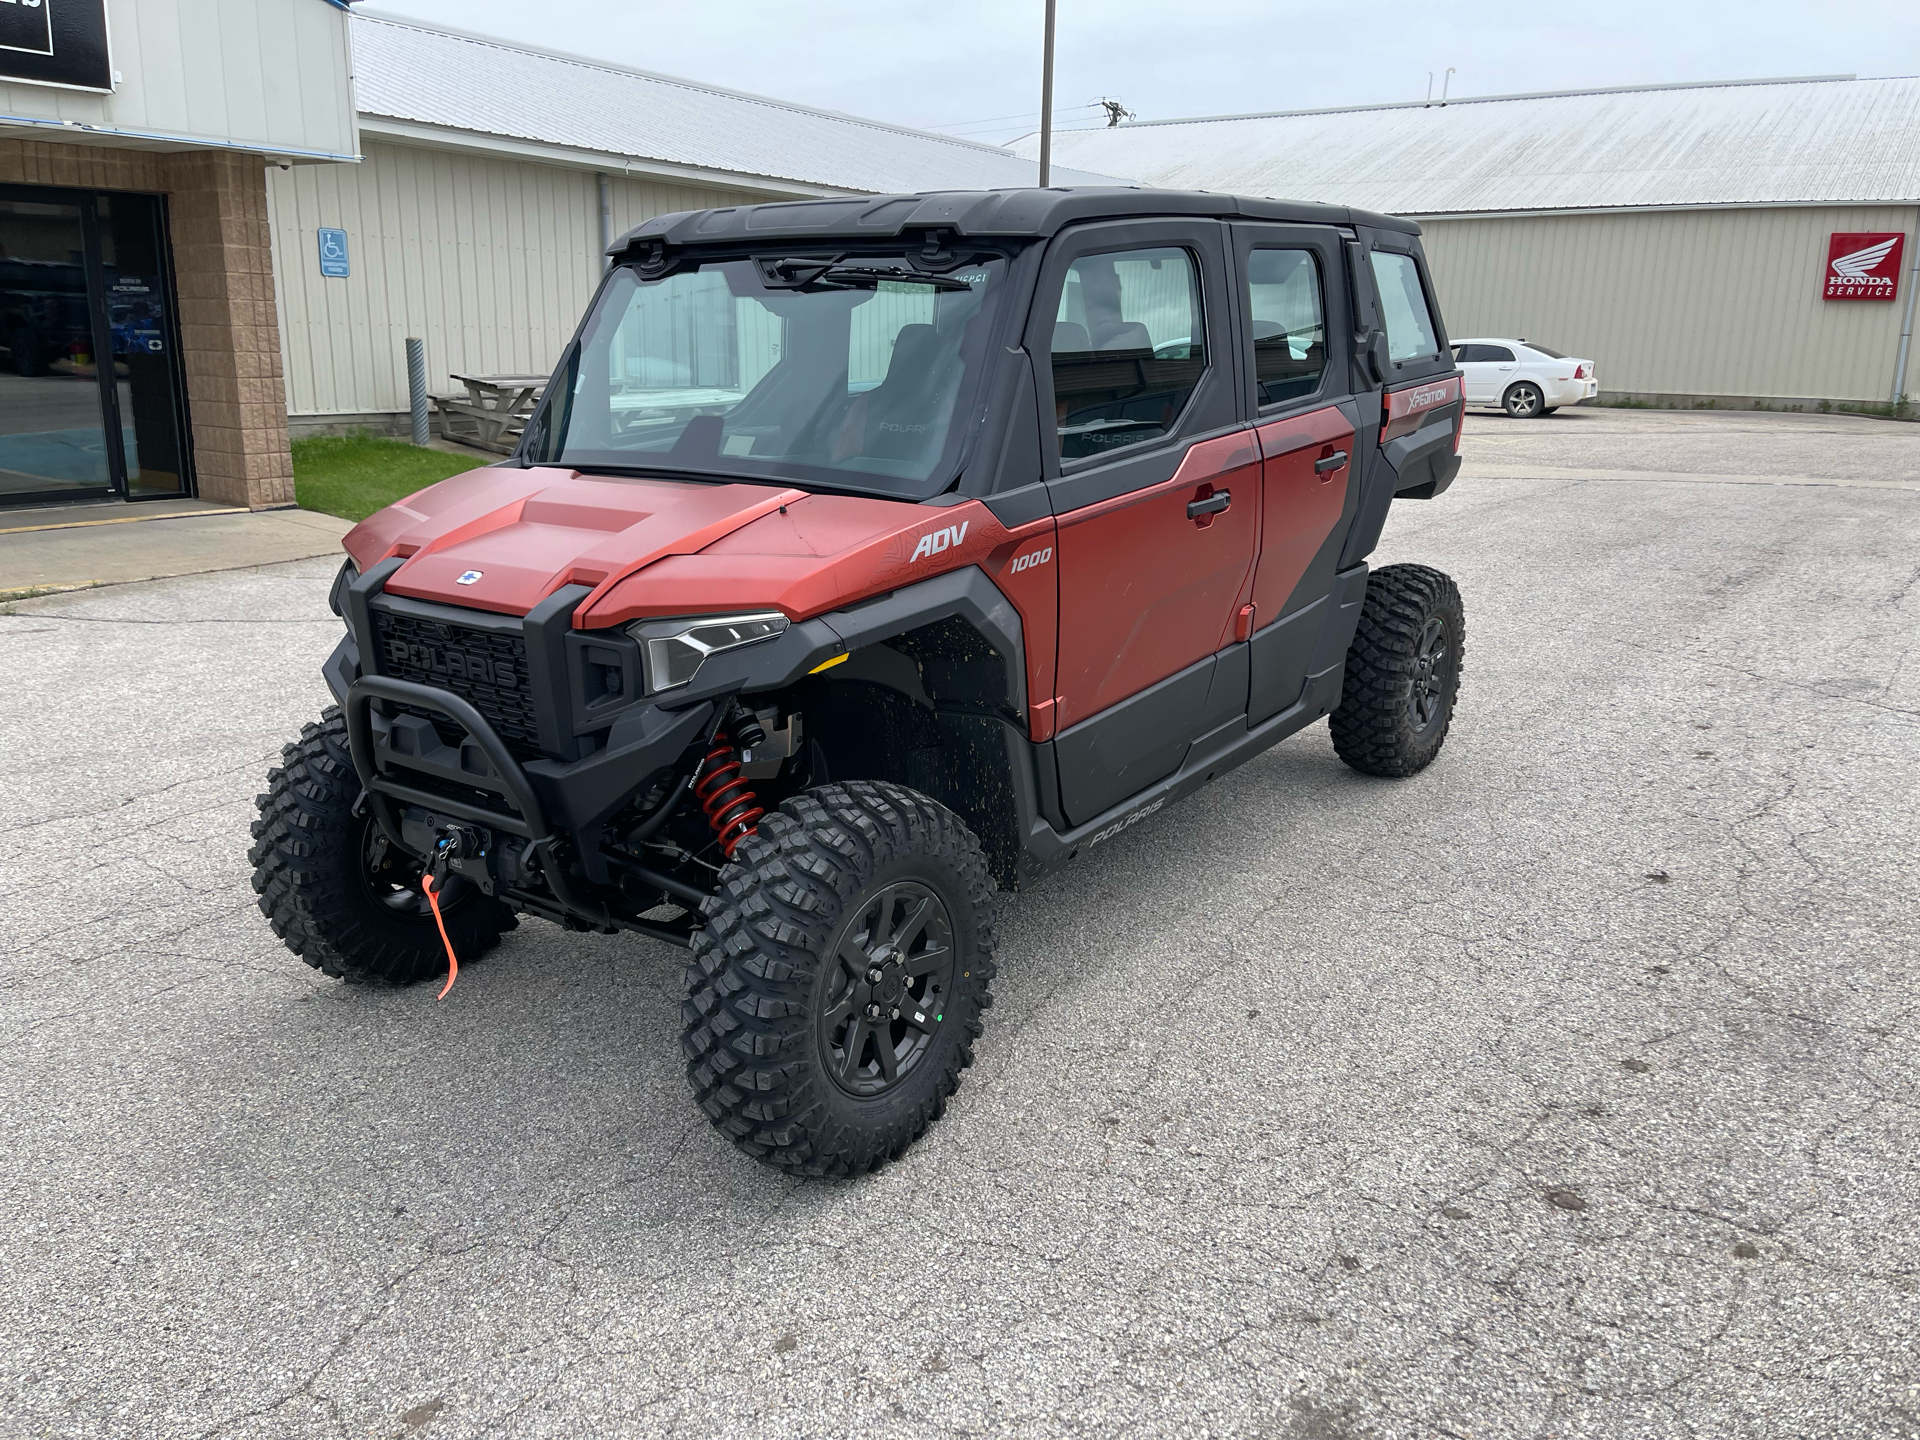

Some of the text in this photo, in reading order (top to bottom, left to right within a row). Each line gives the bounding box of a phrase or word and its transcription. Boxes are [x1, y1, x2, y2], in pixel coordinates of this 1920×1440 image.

[1827, 286, 1893, 296] SERVICE
[1828, 277, 1893, 285] HONDA
[1407, 388, 1447, 415] XPEDITION
[909, 520, 969, 563] ADV
[1010, 547, 1053, 574] 1000
[389, 639, 518, 689] POLARIS
[1089, 796, 1166, 849] POLARIS
